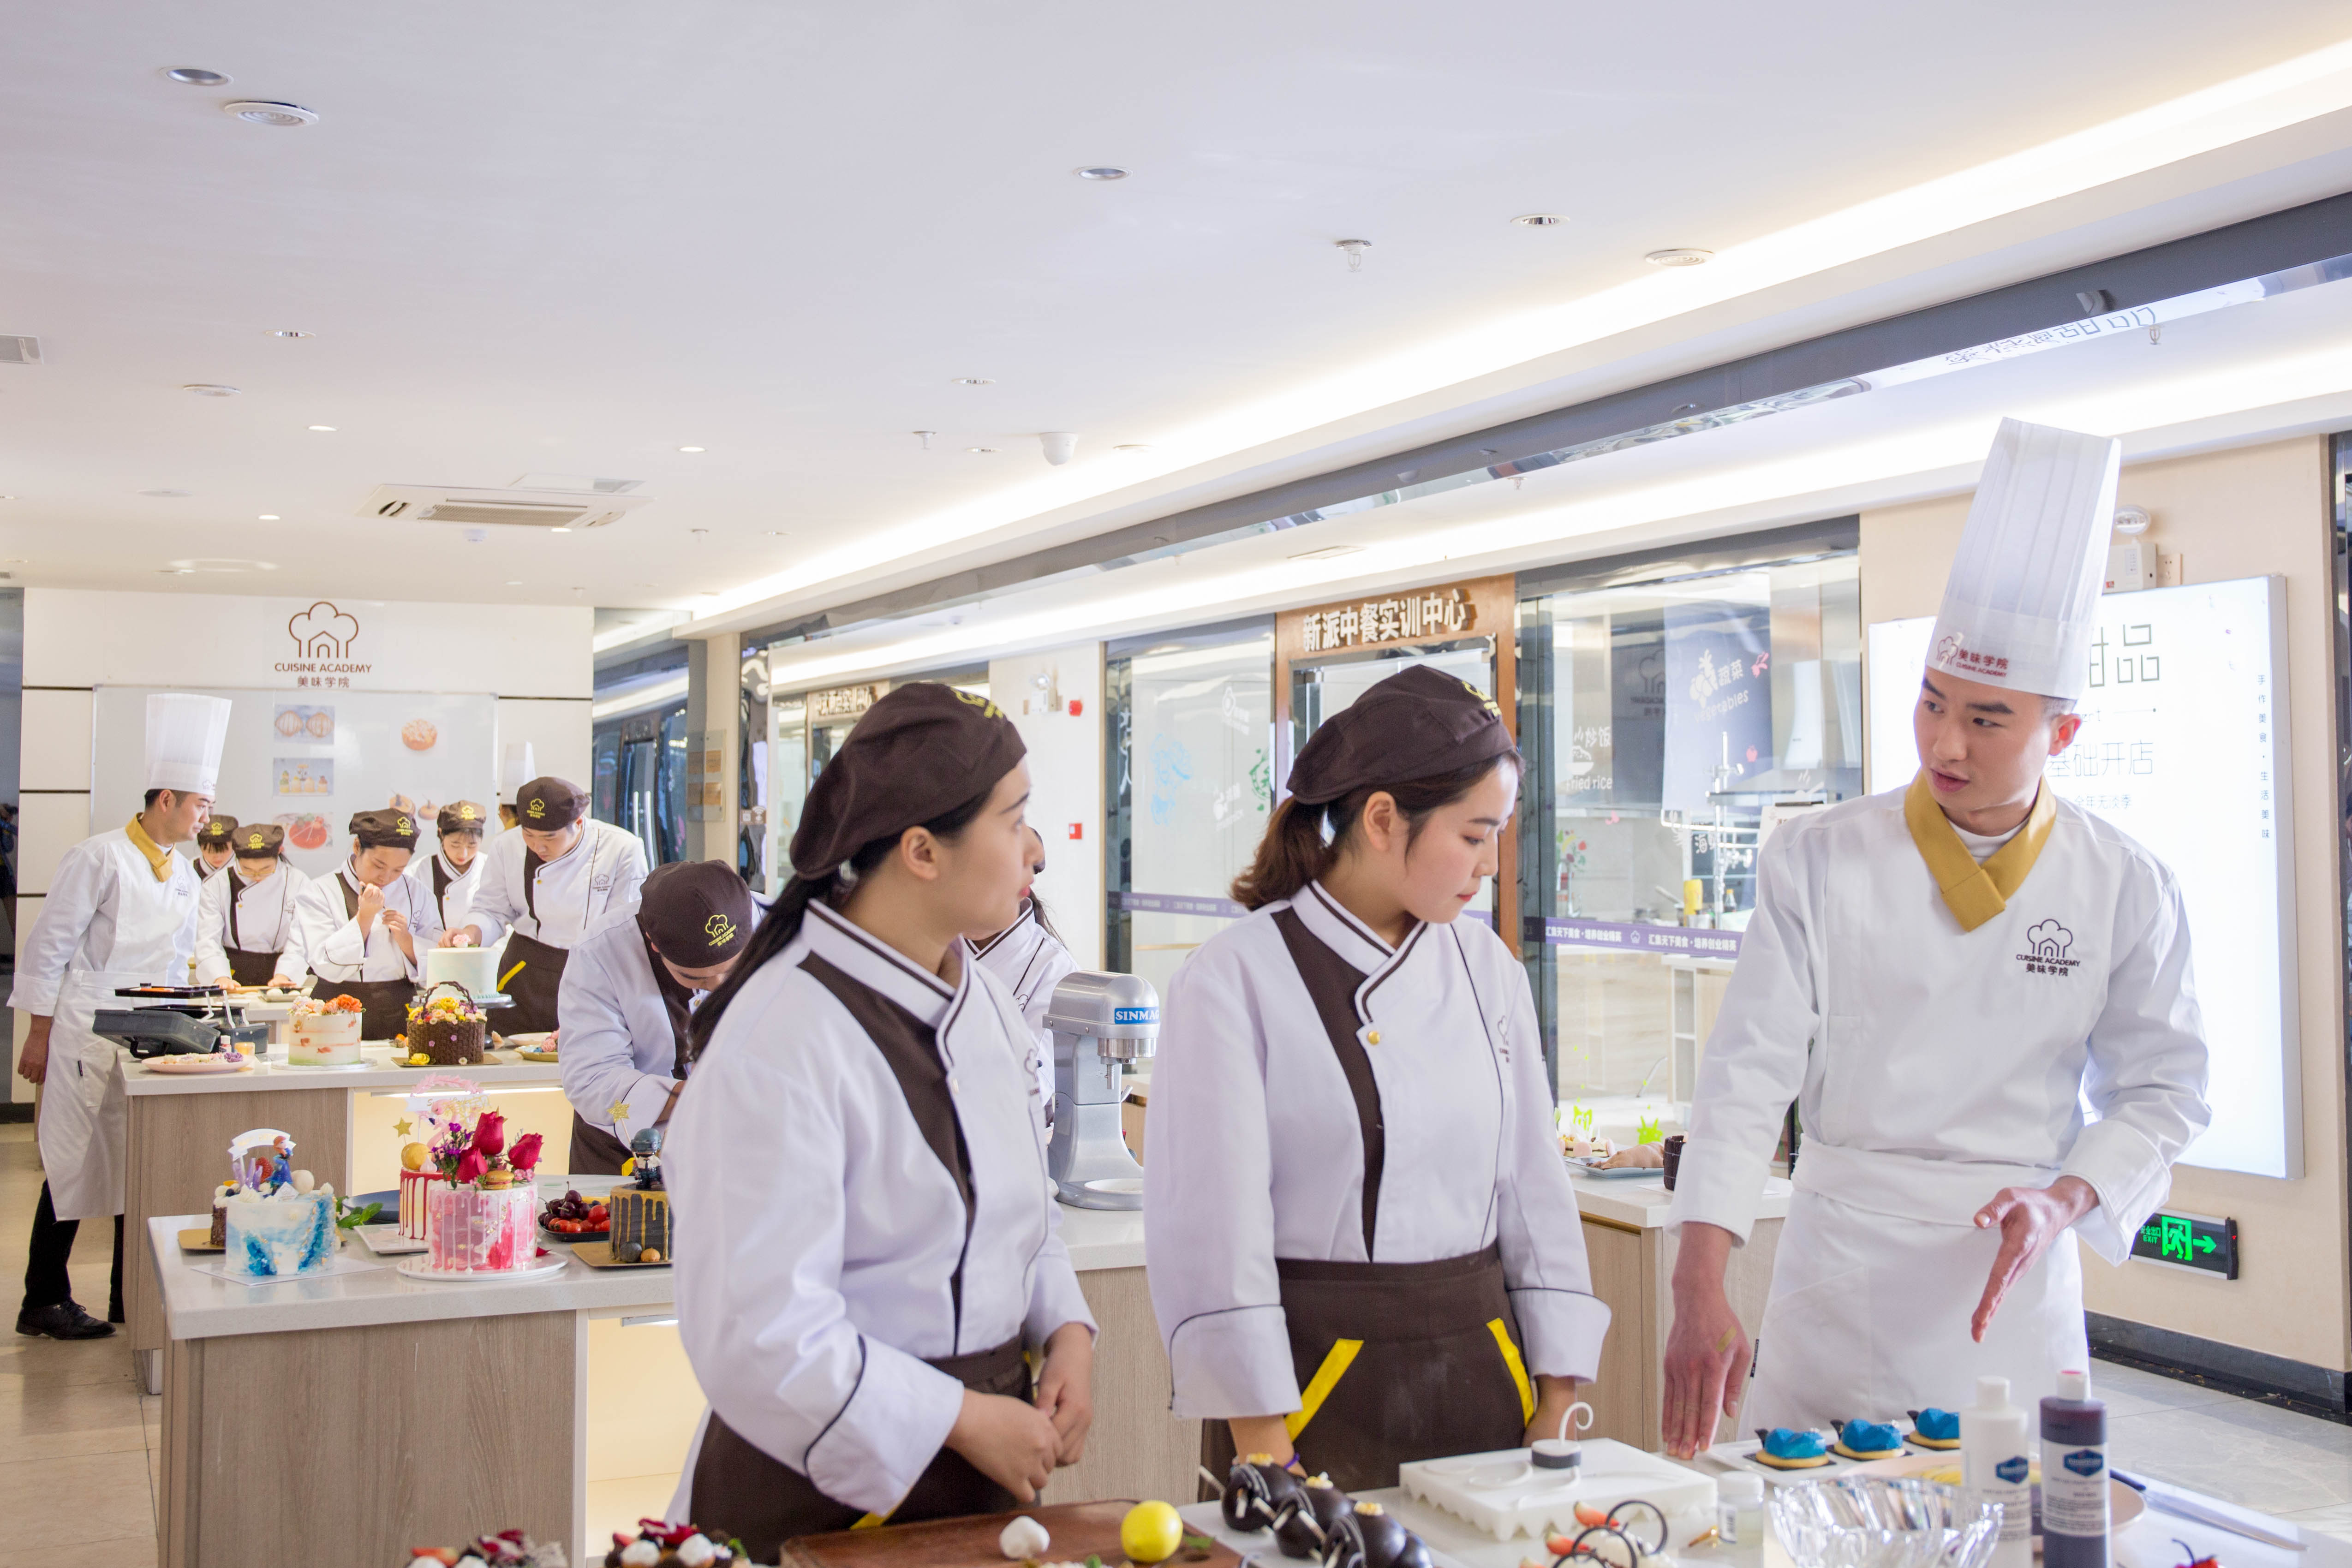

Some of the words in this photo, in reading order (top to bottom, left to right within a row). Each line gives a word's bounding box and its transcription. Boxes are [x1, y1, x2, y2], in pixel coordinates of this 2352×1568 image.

[1303, 588, 1467, 652] 新派中餐实训中心
[1959, 649, 2008, 669] 美味学院
[275, 663, 316, 672] CUISINE
[319, 664, 372, 673] ACADEMY
[1717, 659, 1743, 686] 蔬菜
[298, 676, 350, 688] 美味学院
[1694, 690, 1749, 723] vegetables
[1585, 726, 1612, 748] 炒饭
[1593, 775, 1613, 790] rice
[1648, 933, 1737, 952] 汇集天下美食·培养创业精英
[2016, 954, 2043, 963] CUISINE
[2045, 957, 2080, 966] ACADEMY
[2026, 963, 2068, 977] 美味学院
[1115, 1010, 1159, 1020] SINMAG
